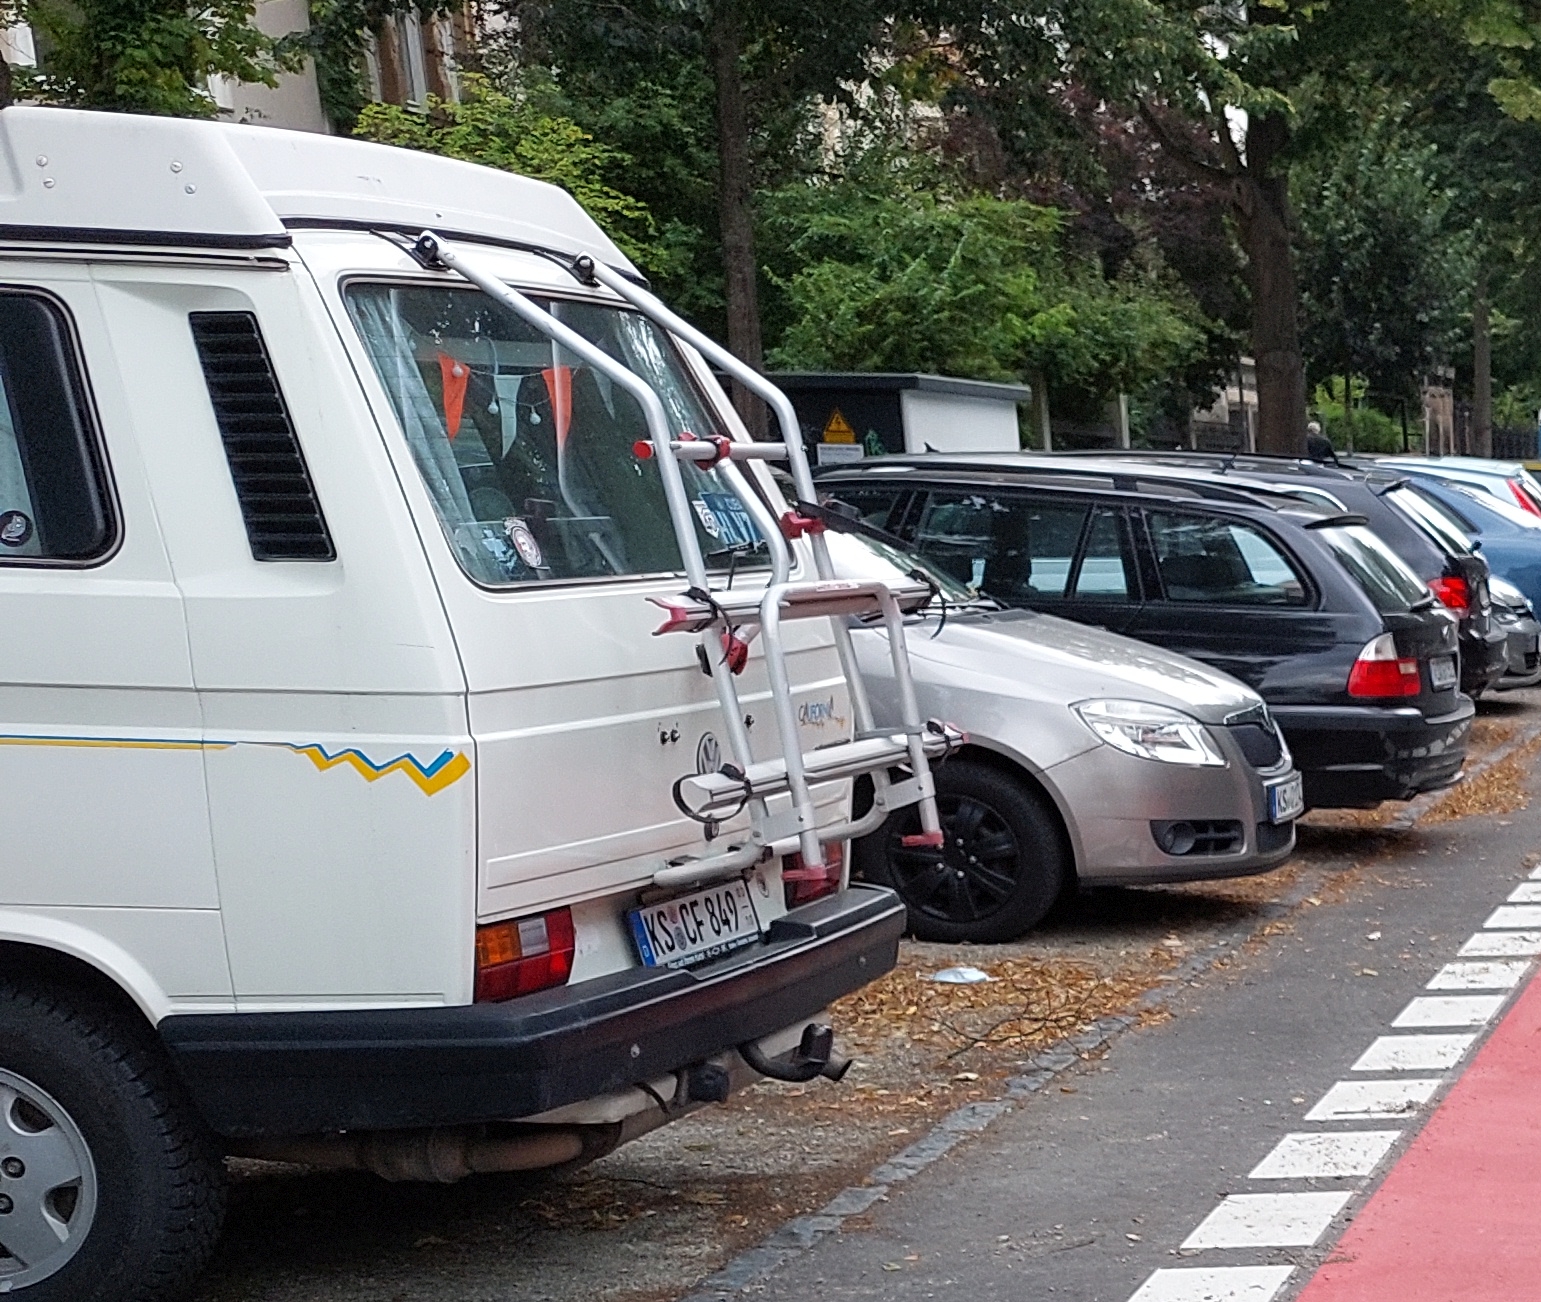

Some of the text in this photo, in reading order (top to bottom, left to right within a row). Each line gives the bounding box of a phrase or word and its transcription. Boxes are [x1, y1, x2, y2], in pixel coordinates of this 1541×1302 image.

[643, 910, 676, 957] KS
[678, 899, 705, 945] CF
[704, 889, 740, 937] 849
